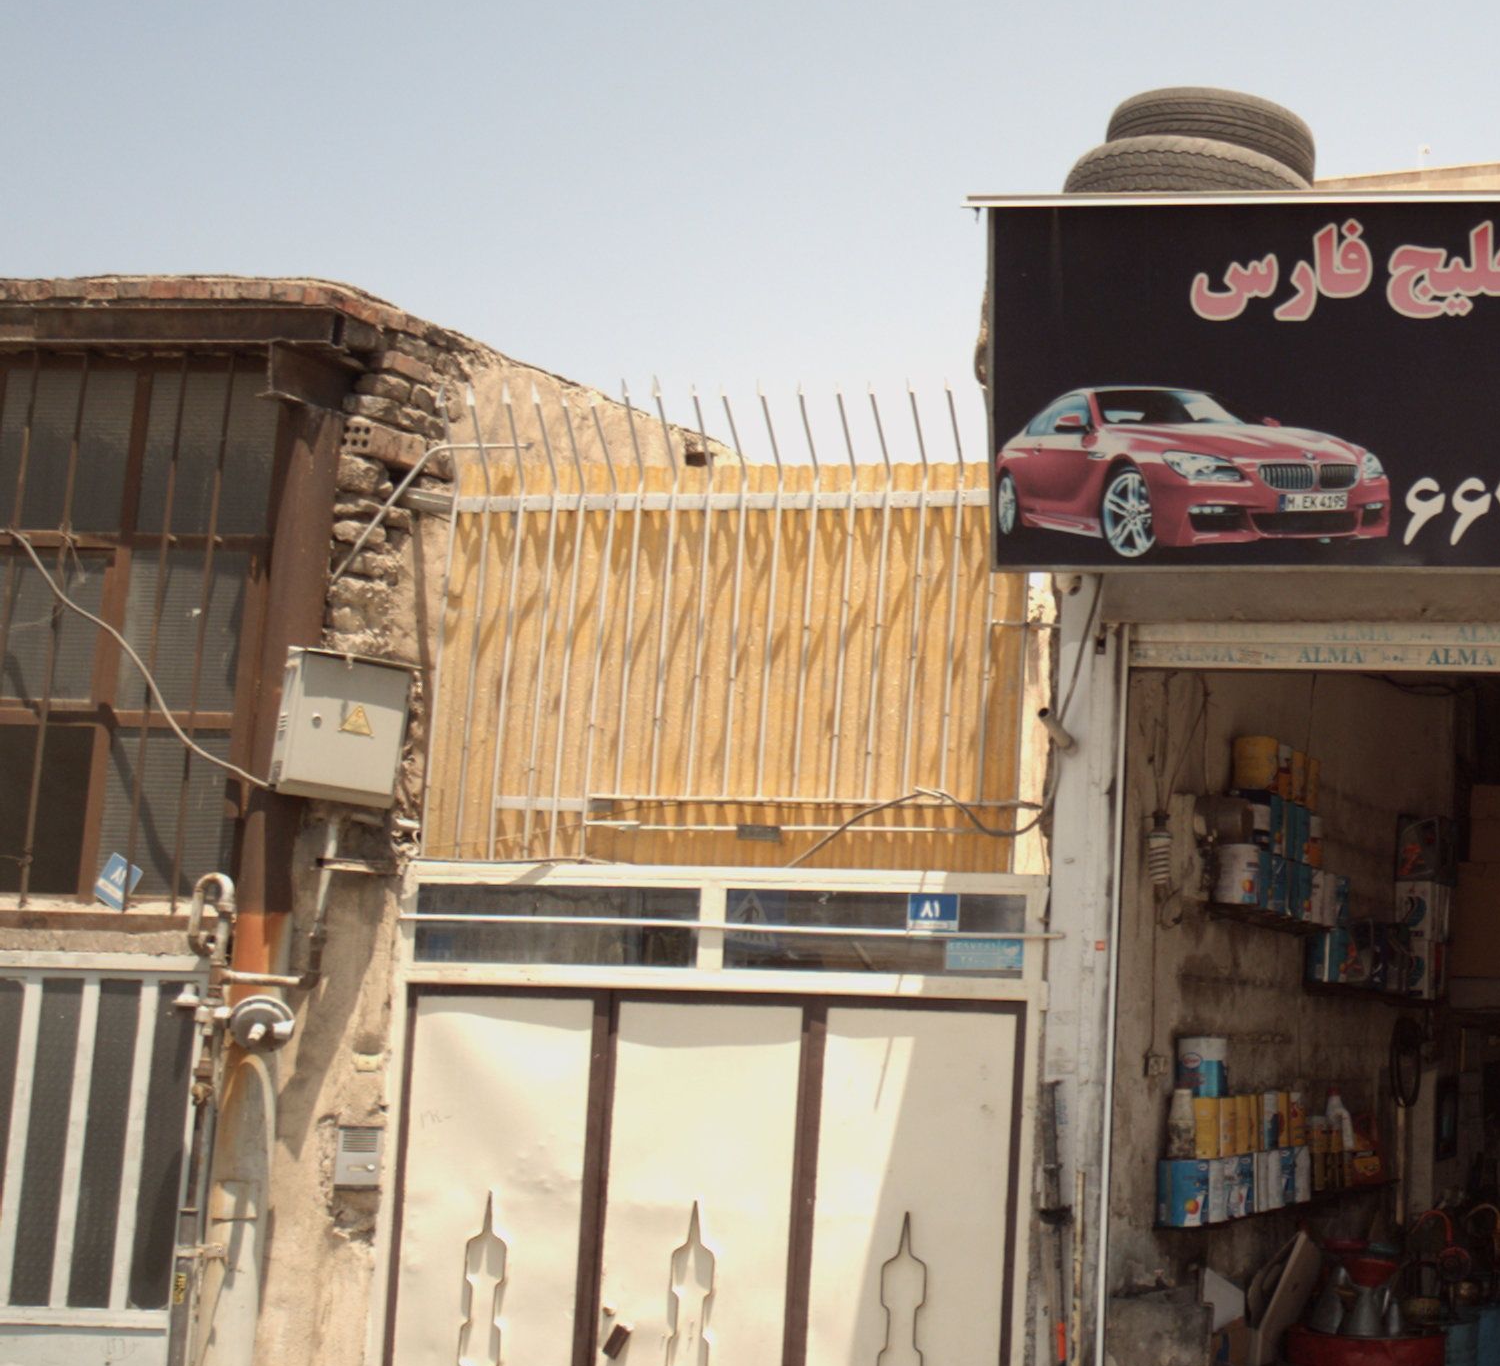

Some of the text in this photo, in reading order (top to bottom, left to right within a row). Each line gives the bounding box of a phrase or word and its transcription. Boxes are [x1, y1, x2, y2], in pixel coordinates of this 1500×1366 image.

[1190, 219, 1372, 321] فارس
[1297, 646, 1363, 664] ALMA
[1427, 648, 1494, 667] ALMA
[920, 899, 941, 919] ۸۱
